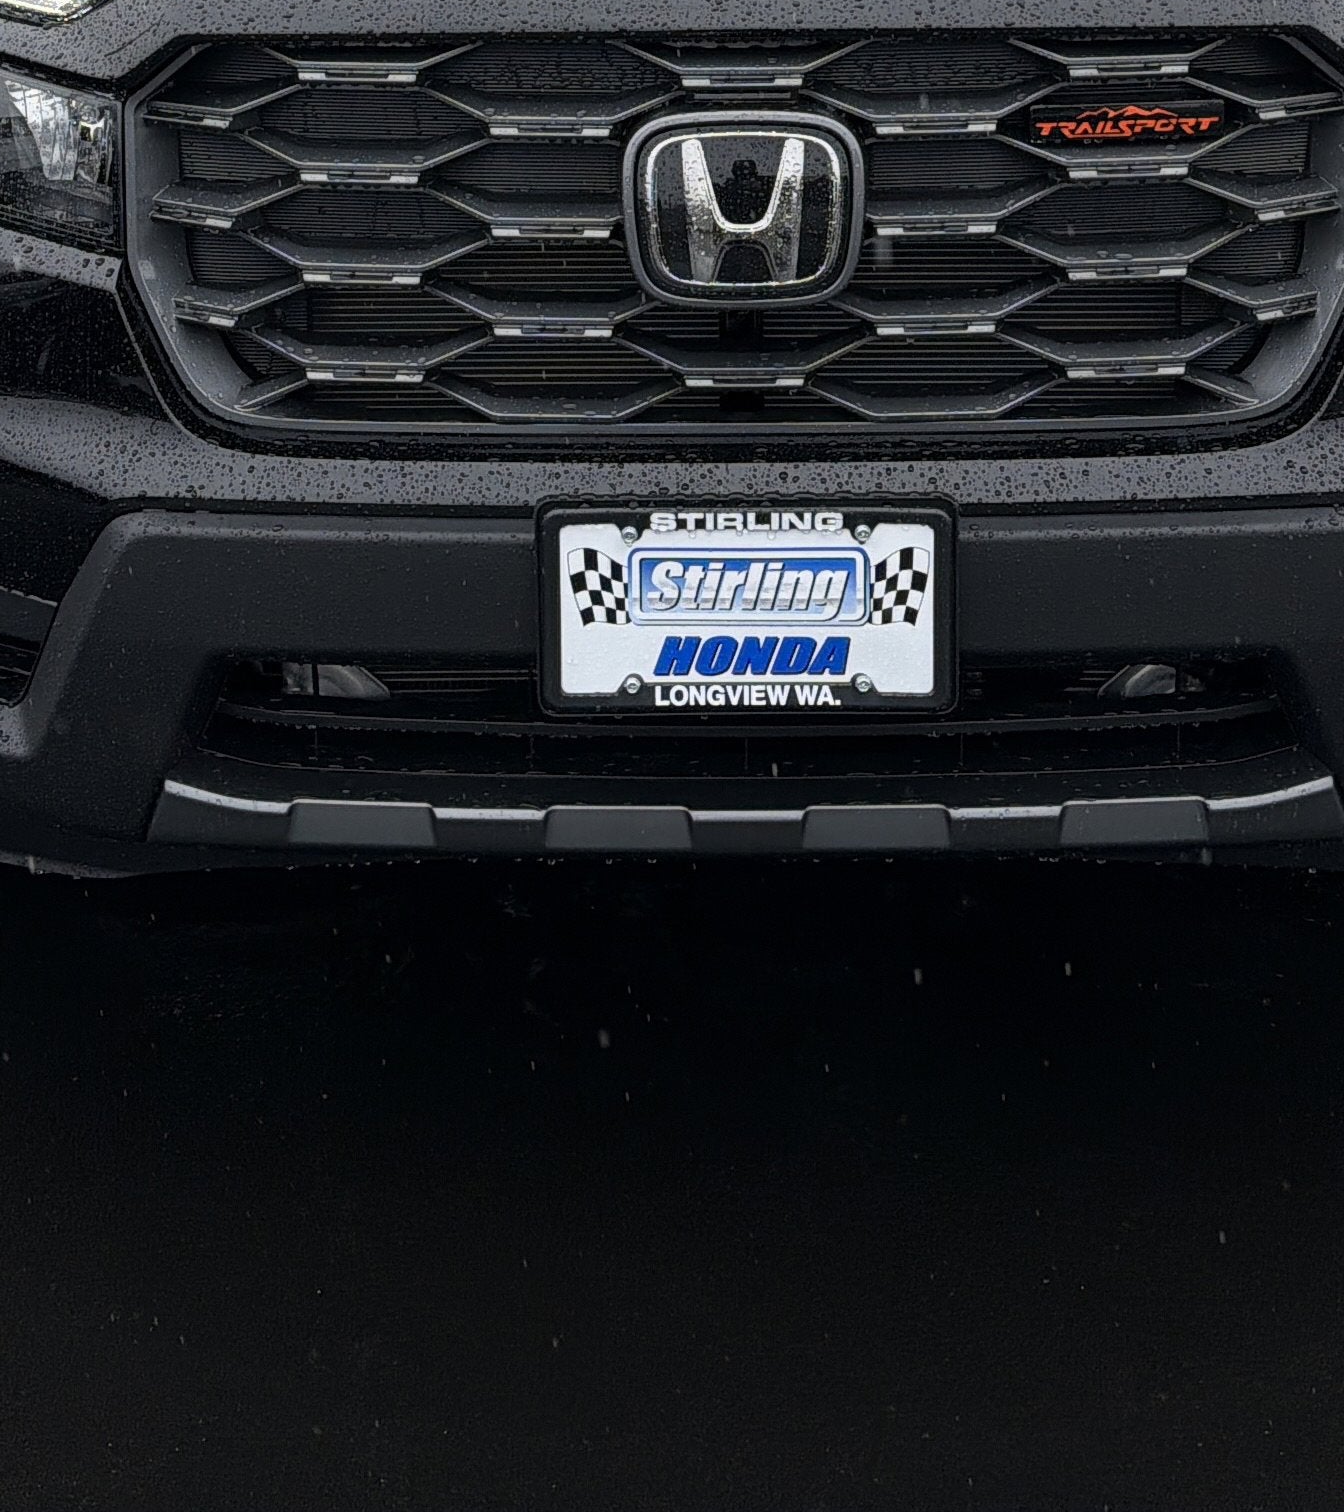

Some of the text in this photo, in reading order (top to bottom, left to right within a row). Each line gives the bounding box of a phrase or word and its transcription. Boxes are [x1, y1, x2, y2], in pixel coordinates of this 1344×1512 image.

[1035, 116, 1219, 139] TRAILSPORT
[650, 512, 844, 531] STIRLING
[647, 561, 850, 621] Stirling
[653, 636, 851, 676] HONDA
[655, 684, 842, 706] LONGVIEW WA.
